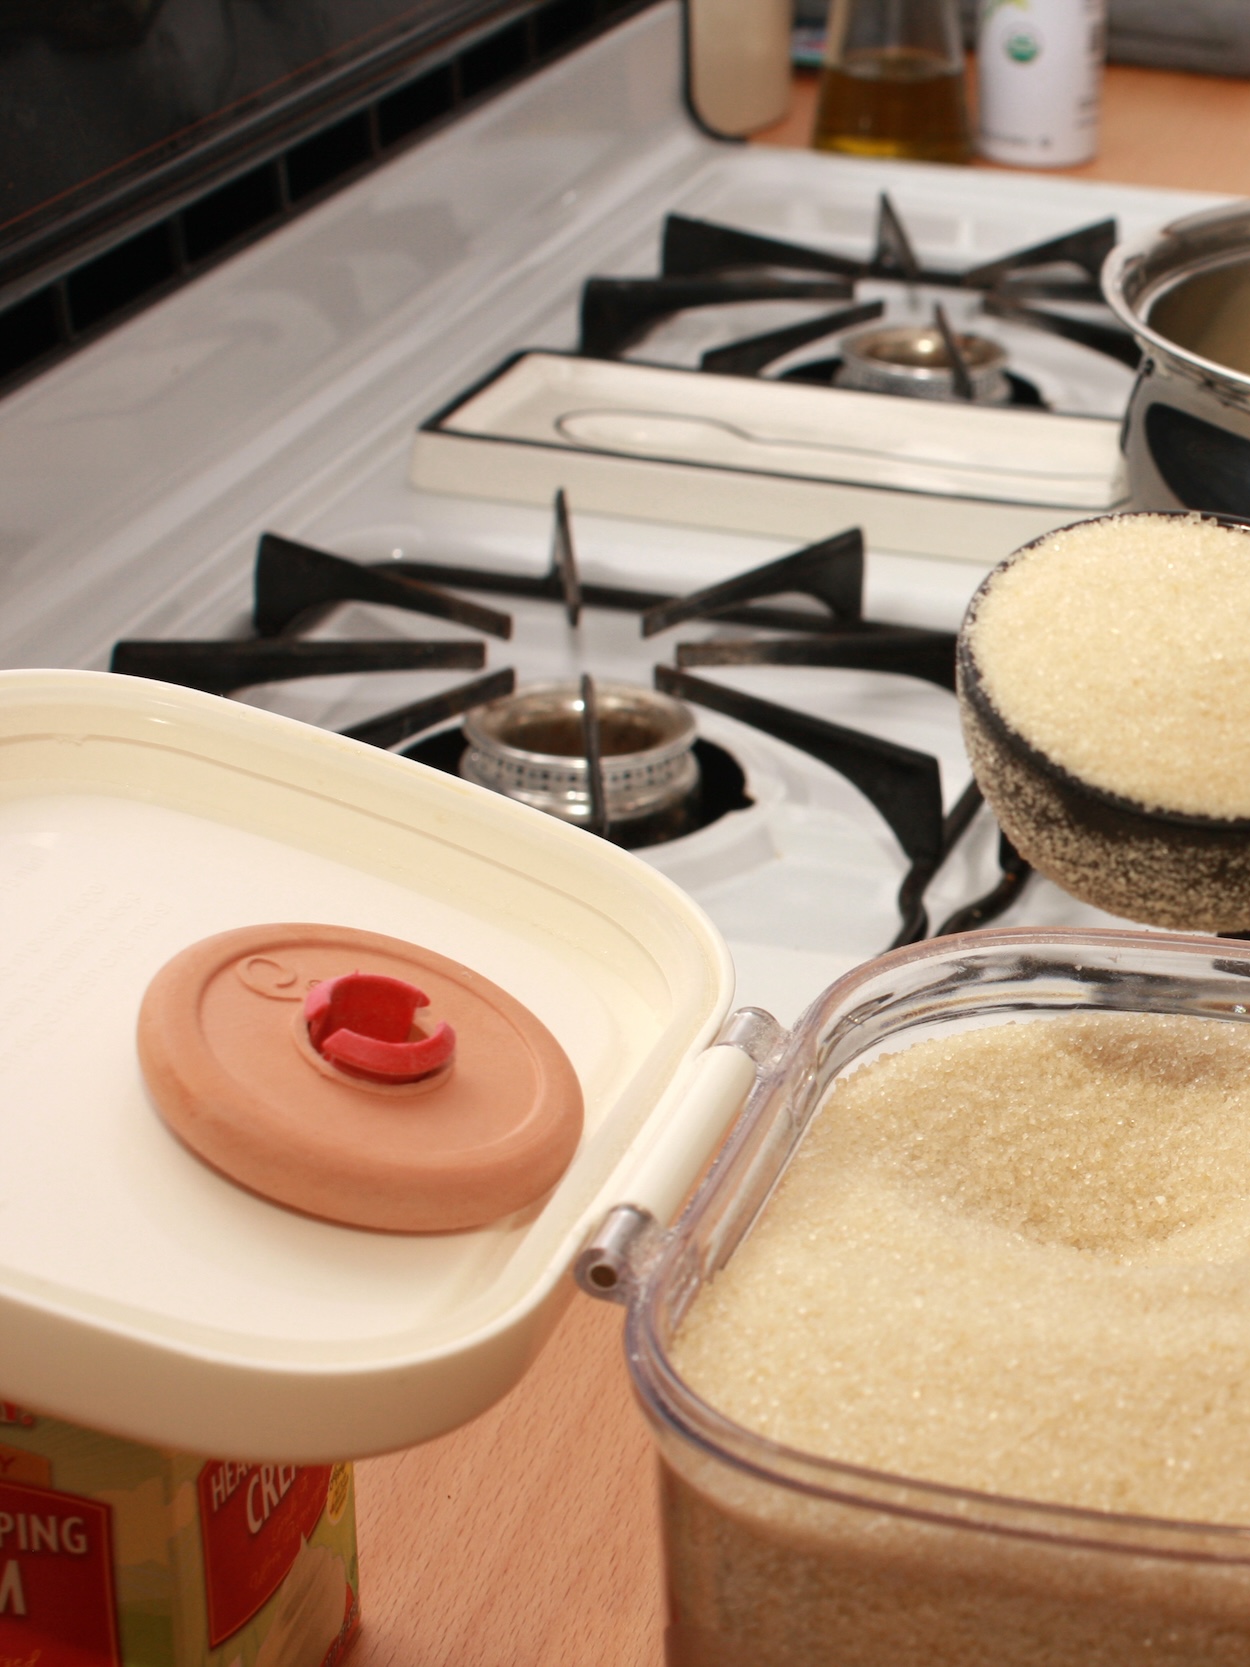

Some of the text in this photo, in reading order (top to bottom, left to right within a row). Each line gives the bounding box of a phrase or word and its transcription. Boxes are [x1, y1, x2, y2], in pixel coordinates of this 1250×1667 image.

[211, 1460, 253, 1513] HEA
[245, 1463, 297, 1535] CRE
[0, 1511, 88, 1555] PING
